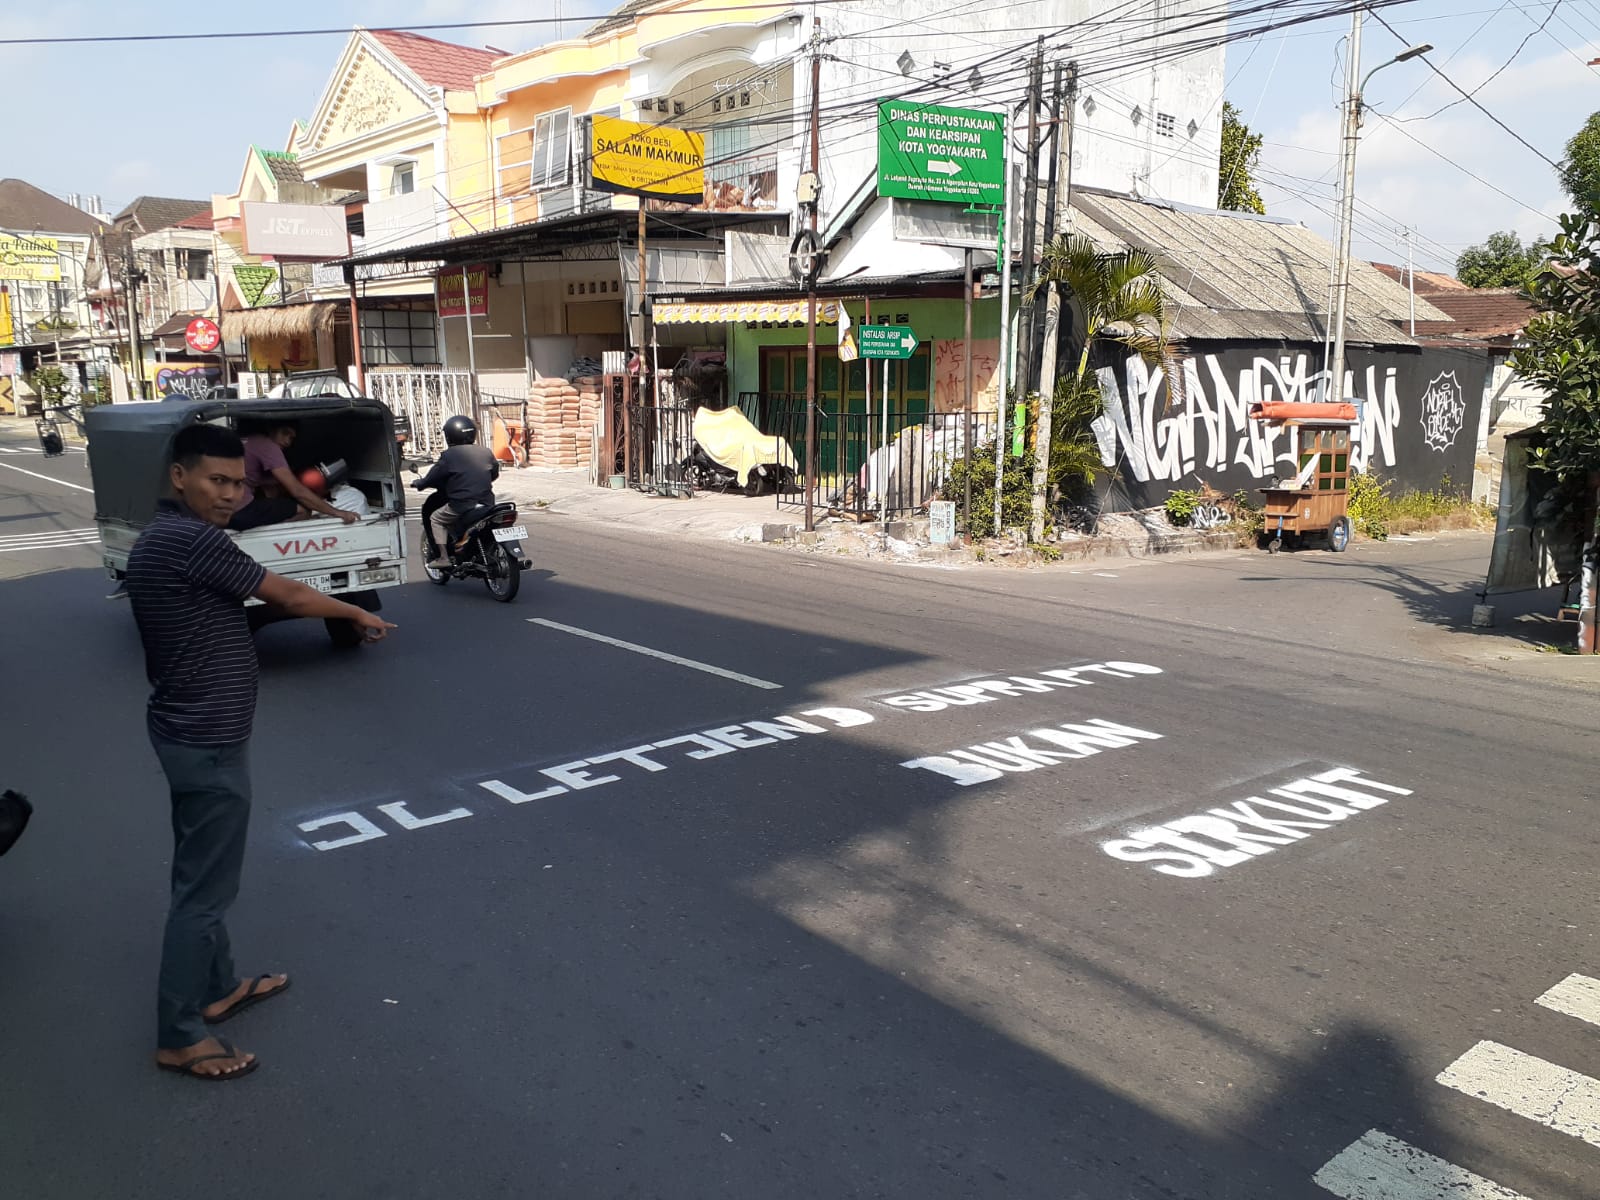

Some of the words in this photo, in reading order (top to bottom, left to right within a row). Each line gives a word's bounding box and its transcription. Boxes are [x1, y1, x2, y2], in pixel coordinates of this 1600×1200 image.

[890, 109, 920, 123] DINAS
[922, 112, 996, 131] PERPUSTAKAAN
[630, 133, 652, 145] TOKO
[653, 137, 671, 148] BESI
[906, 126, 927, 139] DAN
[929, 128, 981, 144] KEARSIPAN
[596, 137, 642, 157] SALAM
[645, 146, 701, 168] MAKMUR
[899, 140, 925, 154] KOTA
[926, 143, 988, 160] YOGYAKARTA
[273, 536, 338, 556] VIAR
[296, 801, 473, 851] JL
[477, 706, 876, 805] LETJEND
[883, 660, 1164, 712] SUPRAPTO
[899, 718, 1165, 787] BUKAN
[1102, 766, 1414, 878] SIRKUIT
